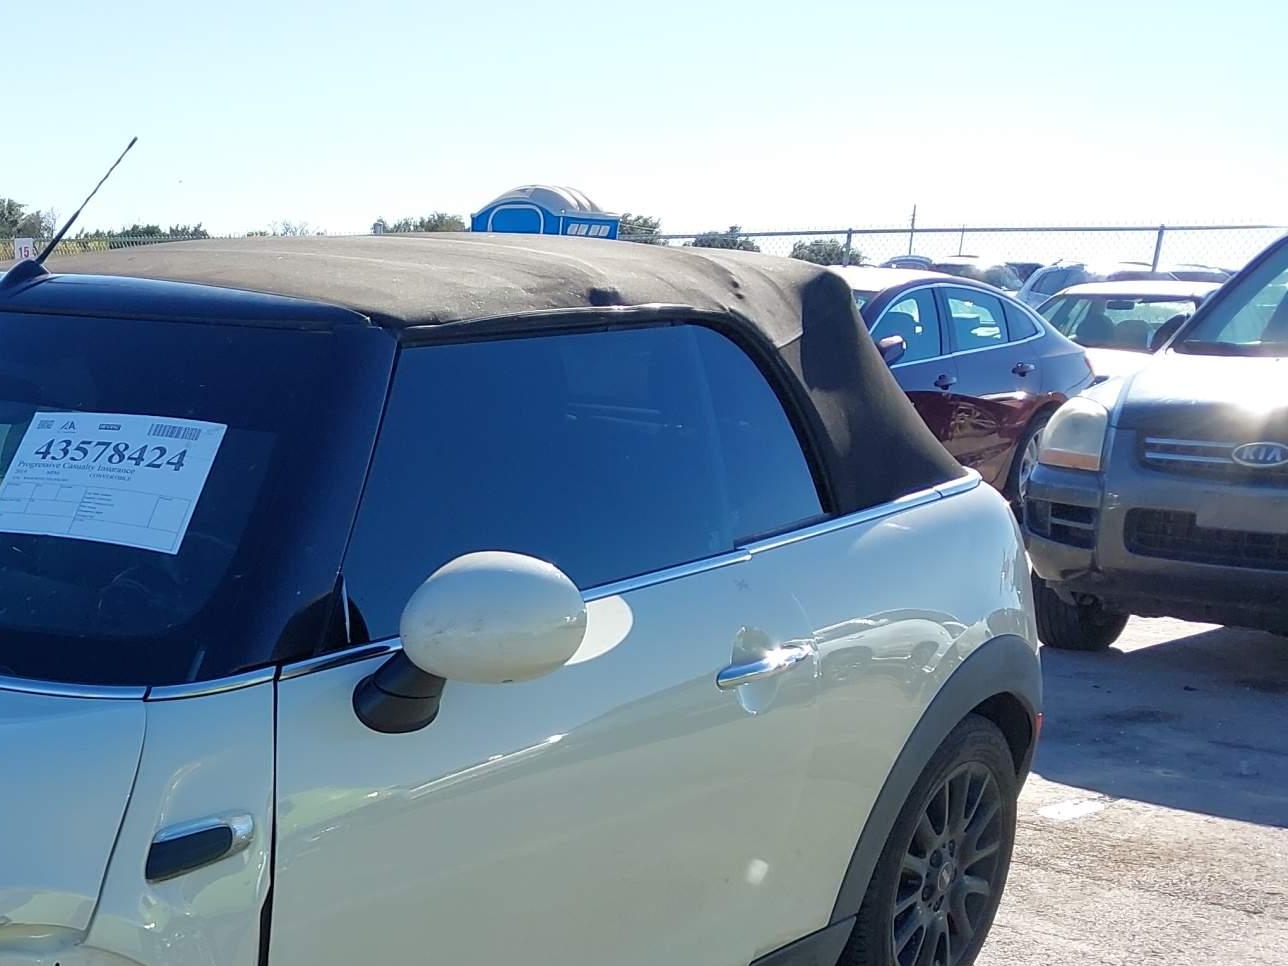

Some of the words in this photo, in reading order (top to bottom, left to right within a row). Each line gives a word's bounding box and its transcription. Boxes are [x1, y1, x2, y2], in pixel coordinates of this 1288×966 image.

[18, 246, 30, 258] 15
[34, 438, 188, 472] 43578424
[1242, 447, 1282, 462] KIA
[17, 460, 61, 470] Progressive
[62, 462, 96, 471] Casualty
[97, 464, 136, 475] Insurance
